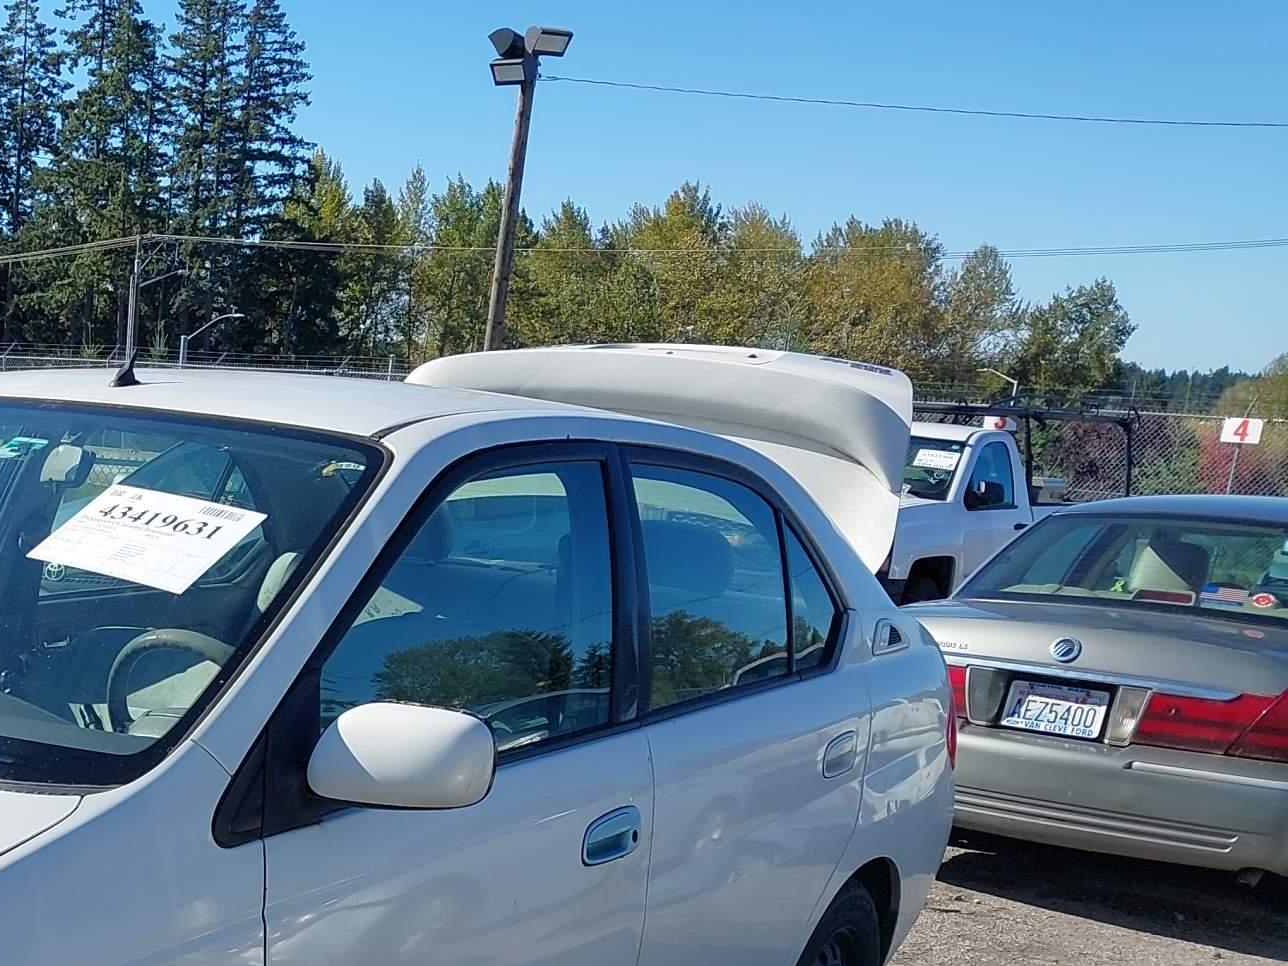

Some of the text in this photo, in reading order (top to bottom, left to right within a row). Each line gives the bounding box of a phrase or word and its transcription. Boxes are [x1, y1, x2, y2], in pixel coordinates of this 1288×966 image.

[1233, 417, 1249, 442] 4
[98, 503, 224, 539] 43419631
[1007, 698, 1097, 728] AEZ5400
[1024, 720, 1041, 729] VAN
[1044, 724, 1067, 733] CLEVE
[1071, 727, 1093, 737] FORD
